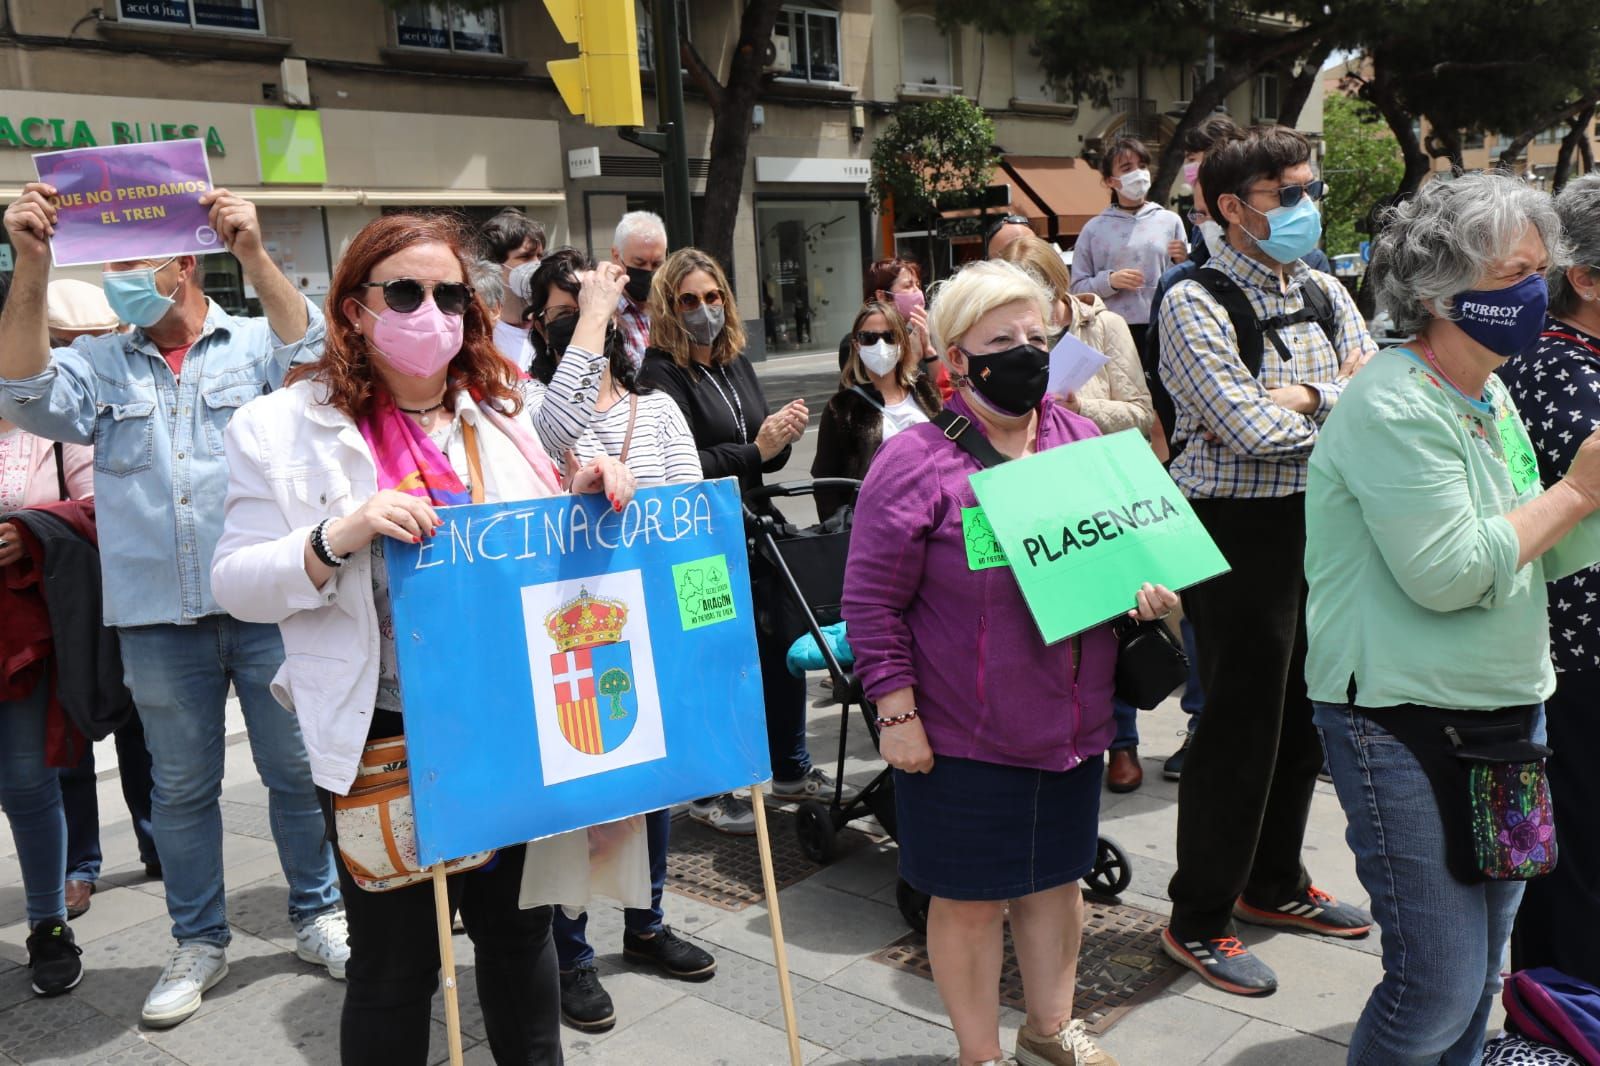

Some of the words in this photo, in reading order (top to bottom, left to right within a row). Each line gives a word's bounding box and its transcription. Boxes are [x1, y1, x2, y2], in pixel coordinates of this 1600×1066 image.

[51, 193, 83, 210] QUE
[87, 190, 113, 204] NO
[117, 180, 207, 201] PERDAMOS
[101, 211, 120, 225] EL
[122, 205, 166, 222] TREN
[1462, 301, 1524, 318] PURROY
[415, 493, 713, 570] ENCINACORBA
[1022, 495, 1180, 567] PLASENCIA
[703, 593, 731, 611] ARAGÓN
